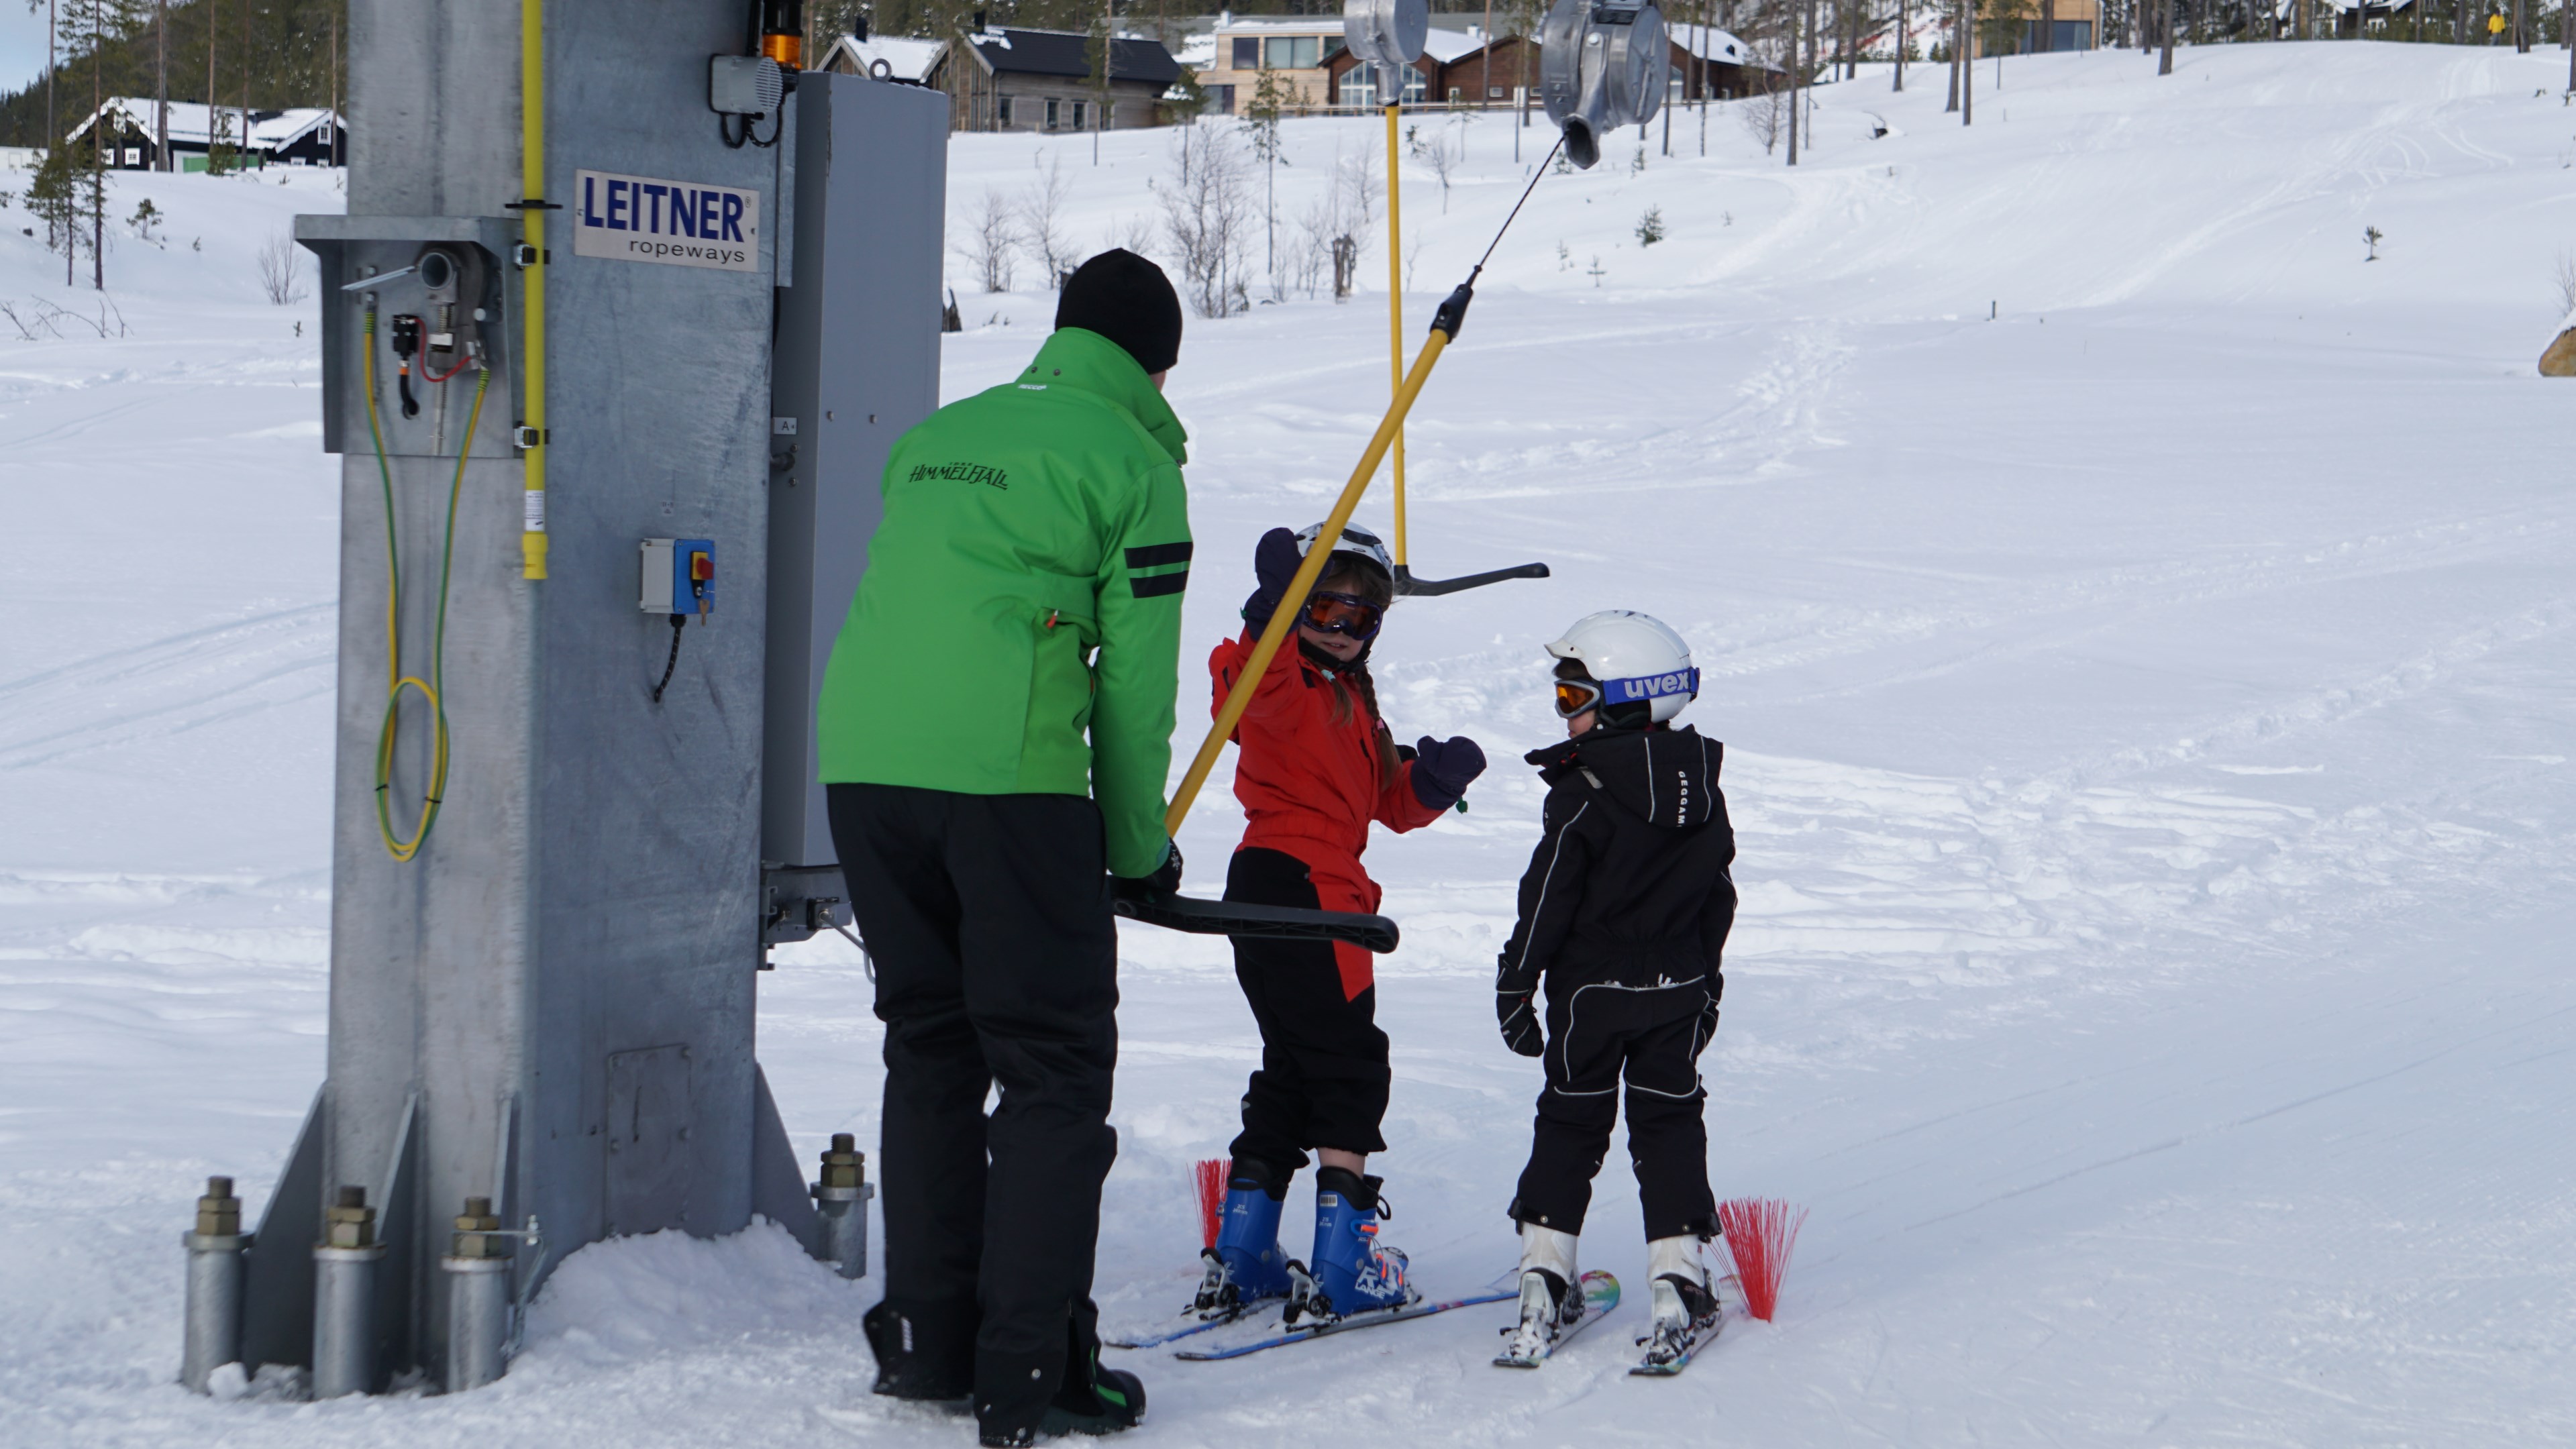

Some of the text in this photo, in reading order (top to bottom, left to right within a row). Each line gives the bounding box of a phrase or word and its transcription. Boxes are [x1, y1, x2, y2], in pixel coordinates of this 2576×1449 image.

[584, 176, 744, 243] LEITNER
[629, 239, 745, 264] ropeways
[1624, 672, 1690, 698] uvex
[1677, 771, 1688, 827] GEGGAM
[1355, 1282, 1386, 1299] LANGE
